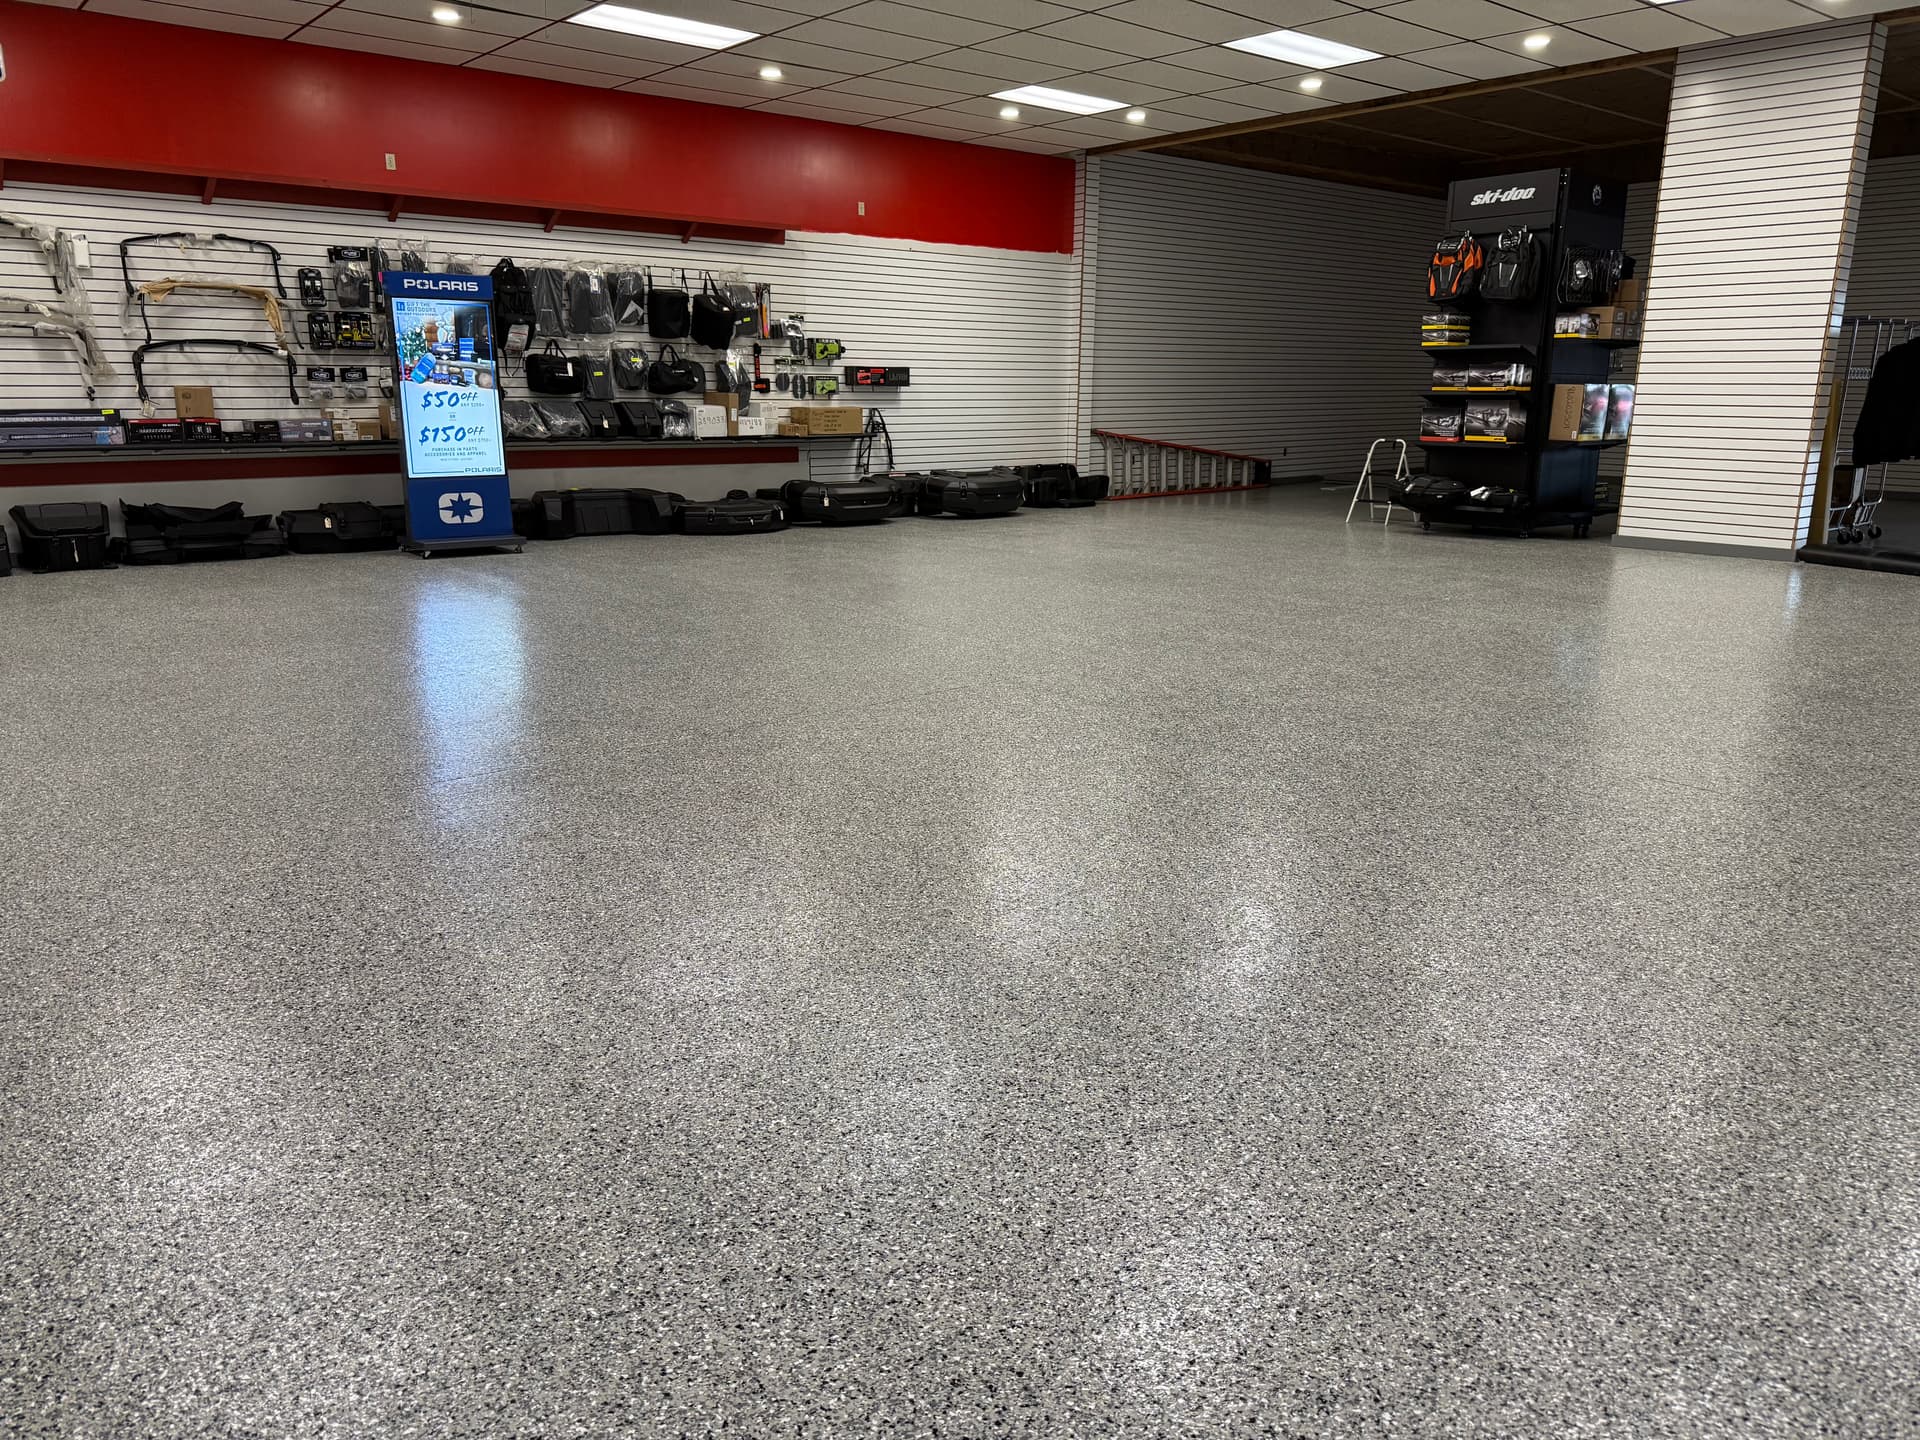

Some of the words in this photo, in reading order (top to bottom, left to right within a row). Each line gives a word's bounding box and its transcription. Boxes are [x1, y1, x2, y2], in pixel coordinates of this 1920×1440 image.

[403, 278, 479, 292] POLARIS
[421, 390, 460, 412] $50
[460, 391, 479, 401] OFF
[418, 425, 467, 447] $150
[467, 426, 486, 436] OFF
